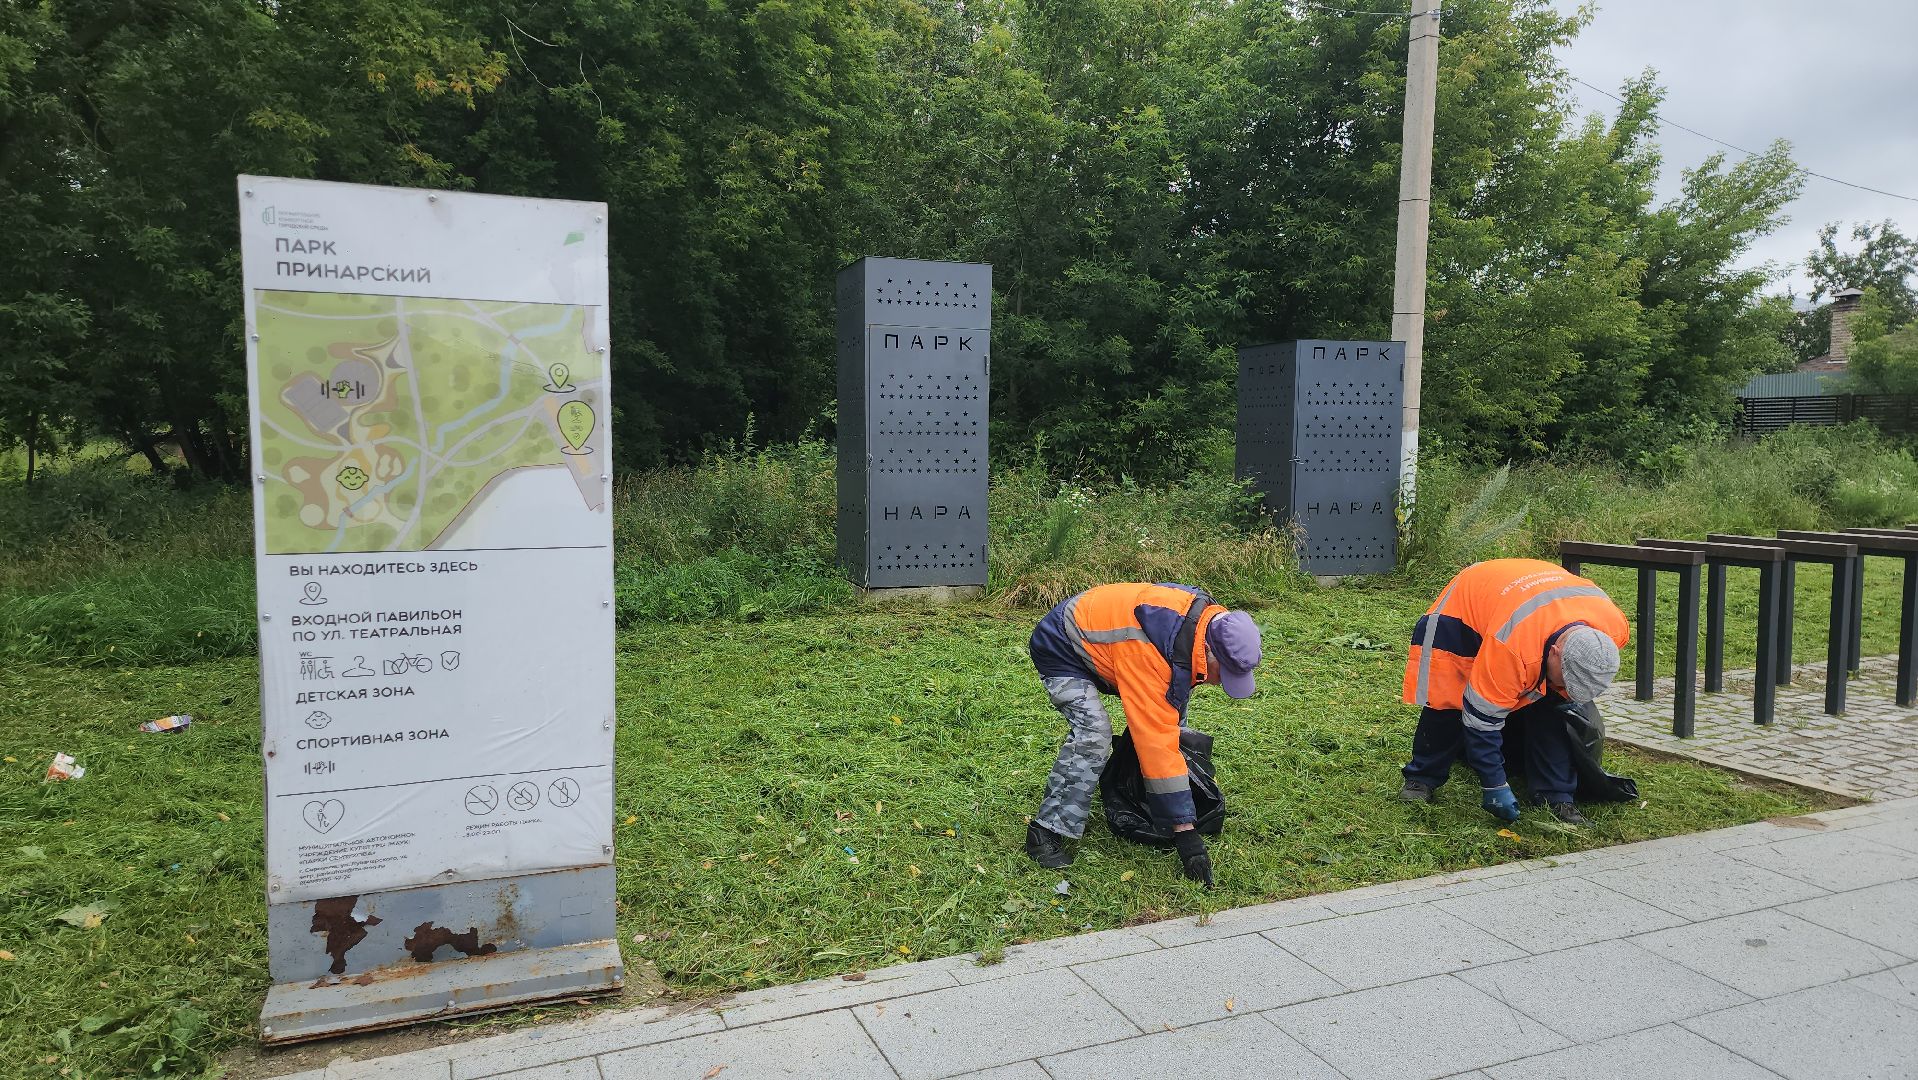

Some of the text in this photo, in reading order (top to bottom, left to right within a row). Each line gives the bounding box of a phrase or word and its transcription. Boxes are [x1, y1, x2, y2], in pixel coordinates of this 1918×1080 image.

[275, 237, 337, 256] ПАРК
[276, 261, 431, 283] ПРИНАРСКИЙ
[884, 333, 973, 351] ПАРК
[1313, 346, 1391, 360] ПАРК
[884, 505, 971, 520] НАРА
[1307, 502, 1383, 515] НАРА
[290, 561, 478, 577] ВЫ НАХОДИТЕСЬ ЗДЕСЬ
[291, 609, 462, 627] ВХОДНОЙ ПАВИЛЬОН
[293, 624, 462, 642] ПО УЛ. ТЕАТРАЛЬНАЯ
[295, 686, 415, 704] ДЕТСКАЯ ЗОНА
[296, 729, 450, 750] СПОРТИВНАЯ ЗОНА
[465, 823, 490, 832] РЕЖИМ
[491, 820, 518, 828] РАБОТЫ
[298, 832, 416, 851] МУНИЦИПАЛЬНОЕ АВТОНОМНОЕ
[298, 847, 348, 858] УЧРЕЖДЕНИЕ
[349, 843, 386, 853] КУЛЬТУРЫ
